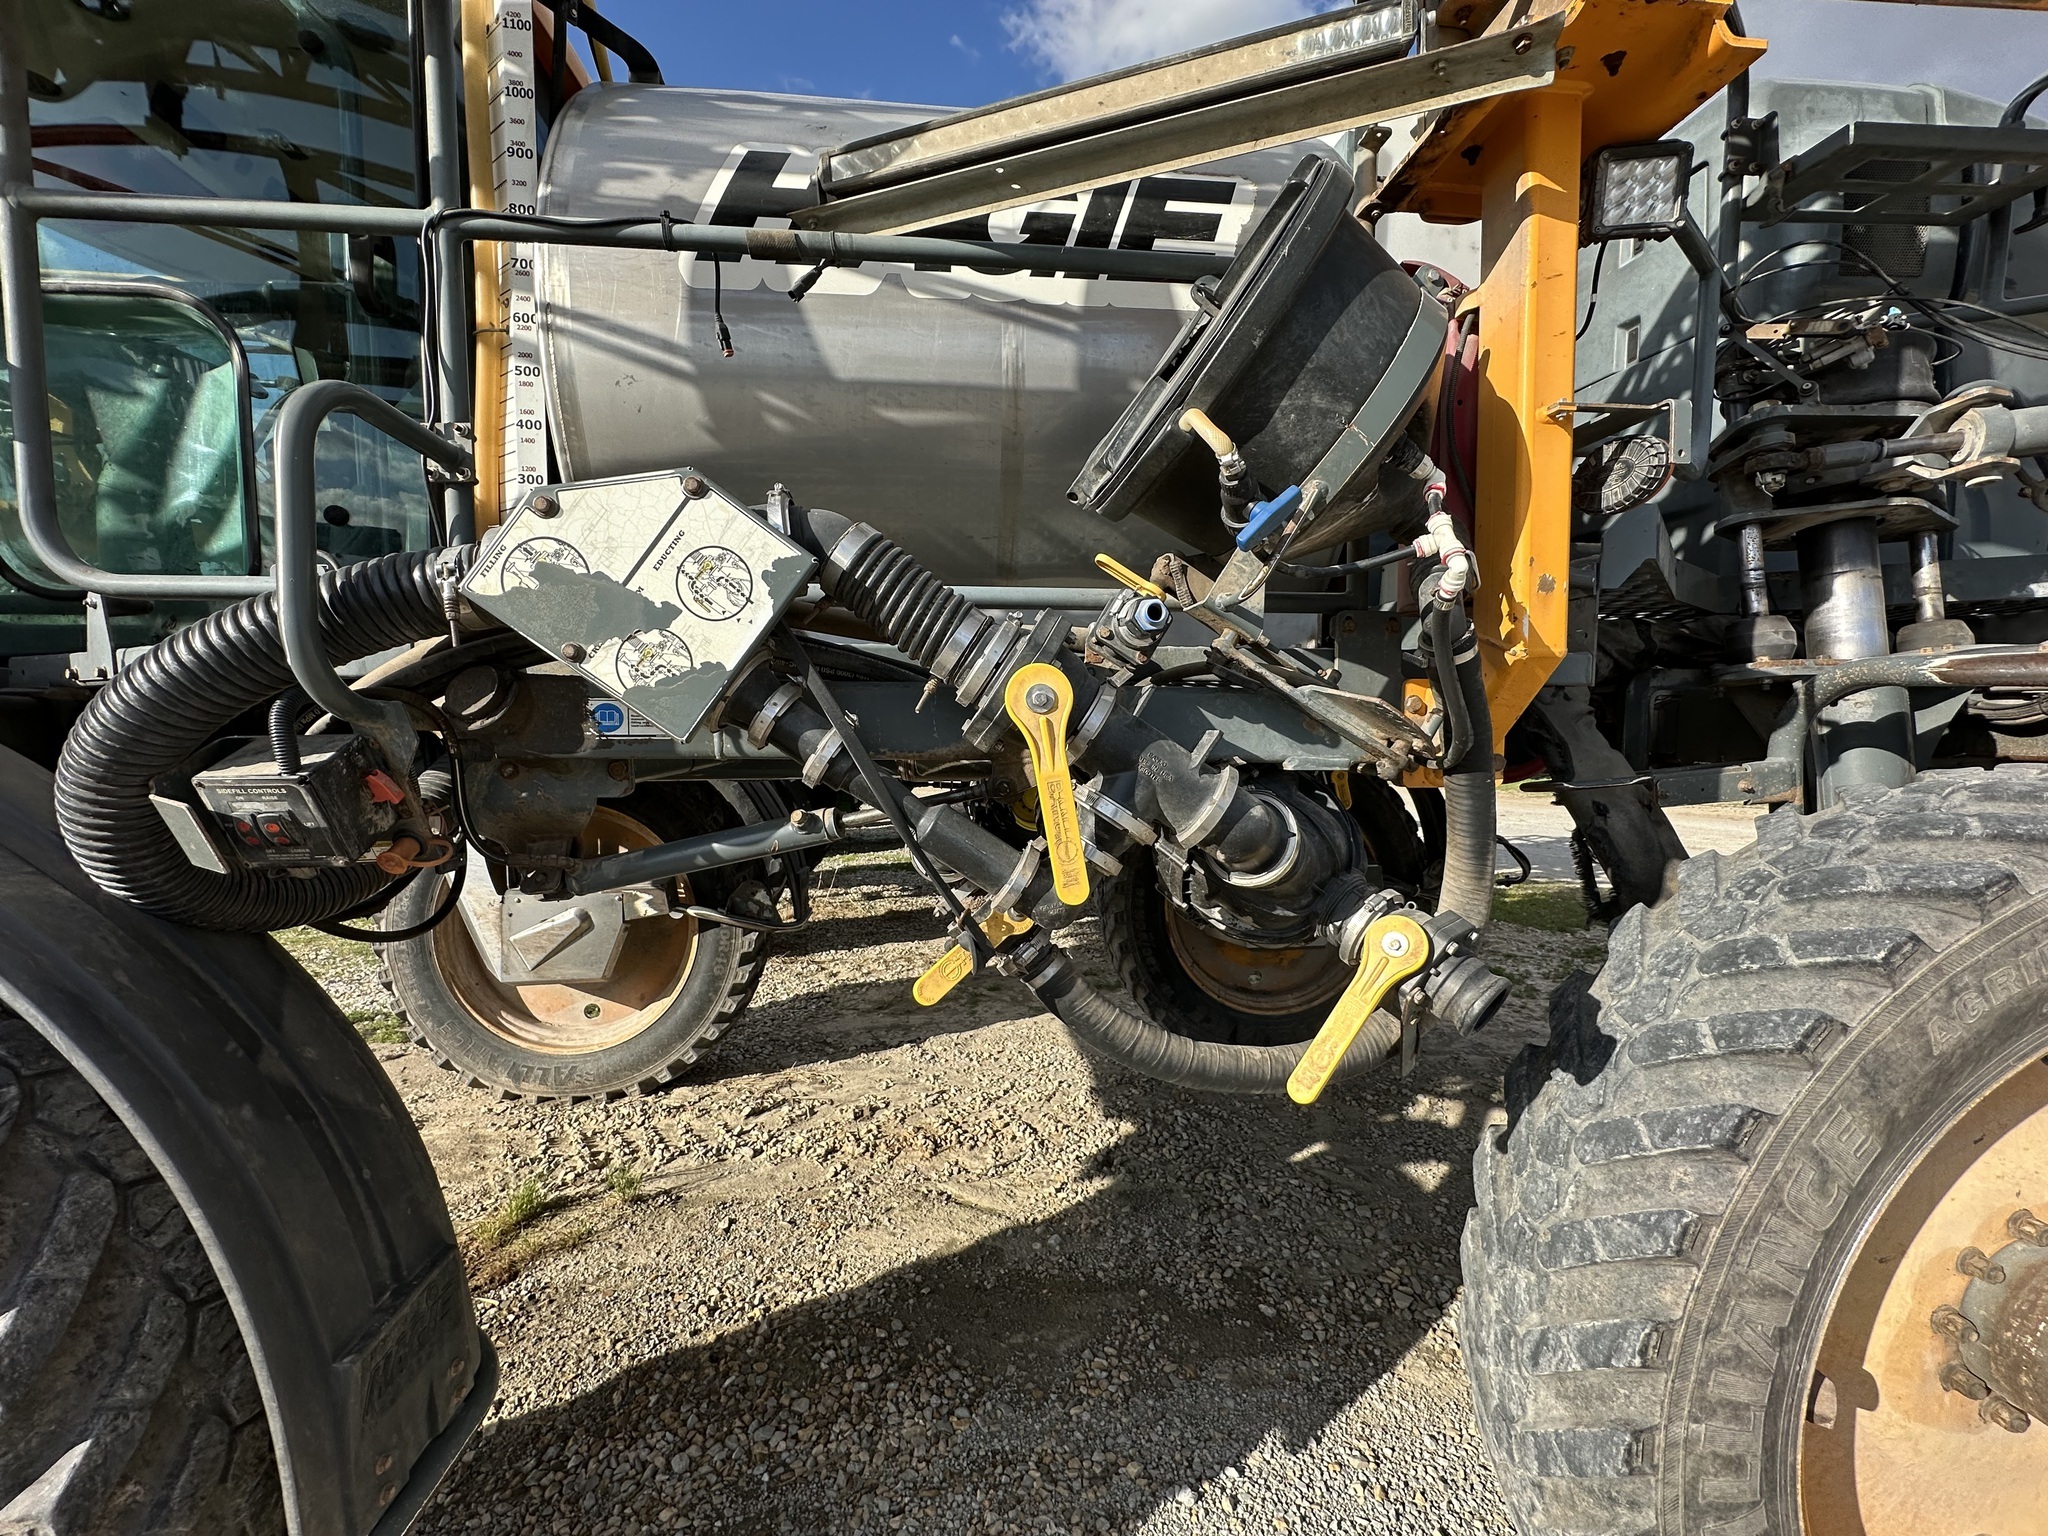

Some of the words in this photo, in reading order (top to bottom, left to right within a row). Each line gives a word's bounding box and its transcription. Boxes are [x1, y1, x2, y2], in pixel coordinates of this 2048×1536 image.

[502, 18, 531, 31] 1100
[506, 50, 522, 58] 4000
[504, 86, 534, 100] 1000
[510, 140, 526, 148] 3400
[506, 146, 534, 160] 900
[508, 202, 535, 216] 800
[516, 324, 532, 332] 2200
[514, 366, 540, 378] 500
[518, 380, 534, 388] 1800
[519, 408, 535, 416] 1600
[516, 420, 542, 430] 400
[518, 474, 544, 485] 300
[653, 530, 685, 571] EDUCTING
[480, 544, 506, 578] FILLING
